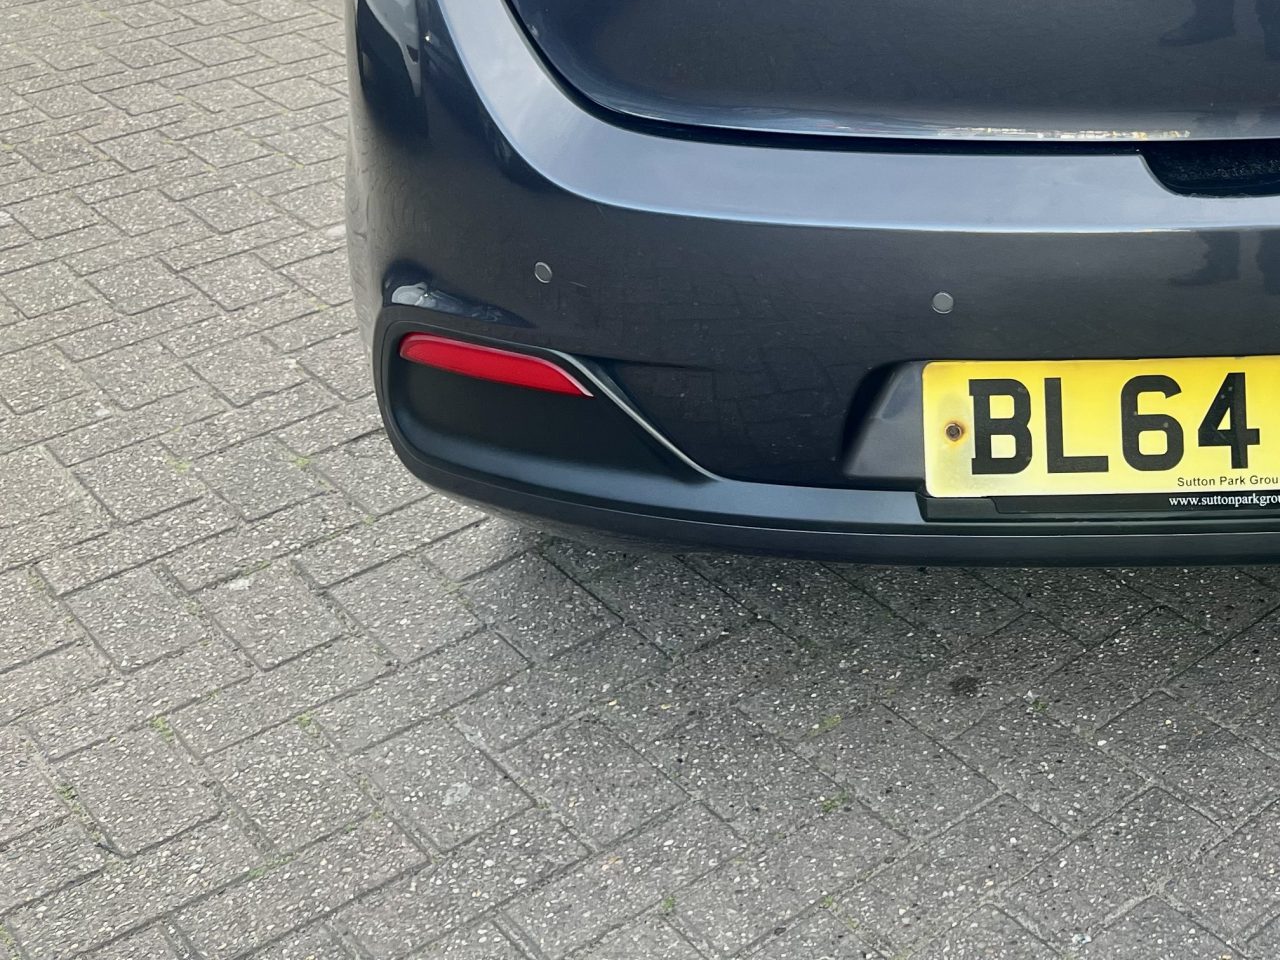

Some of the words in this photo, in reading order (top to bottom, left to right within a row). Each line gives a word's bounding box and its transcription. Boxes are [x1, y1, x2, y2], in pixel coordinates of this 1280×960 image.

[968, 372, 1260, 475] BL64
[1177, 477, 1215, 487] Sutton
[1220, 476, 1246, 486] Park
